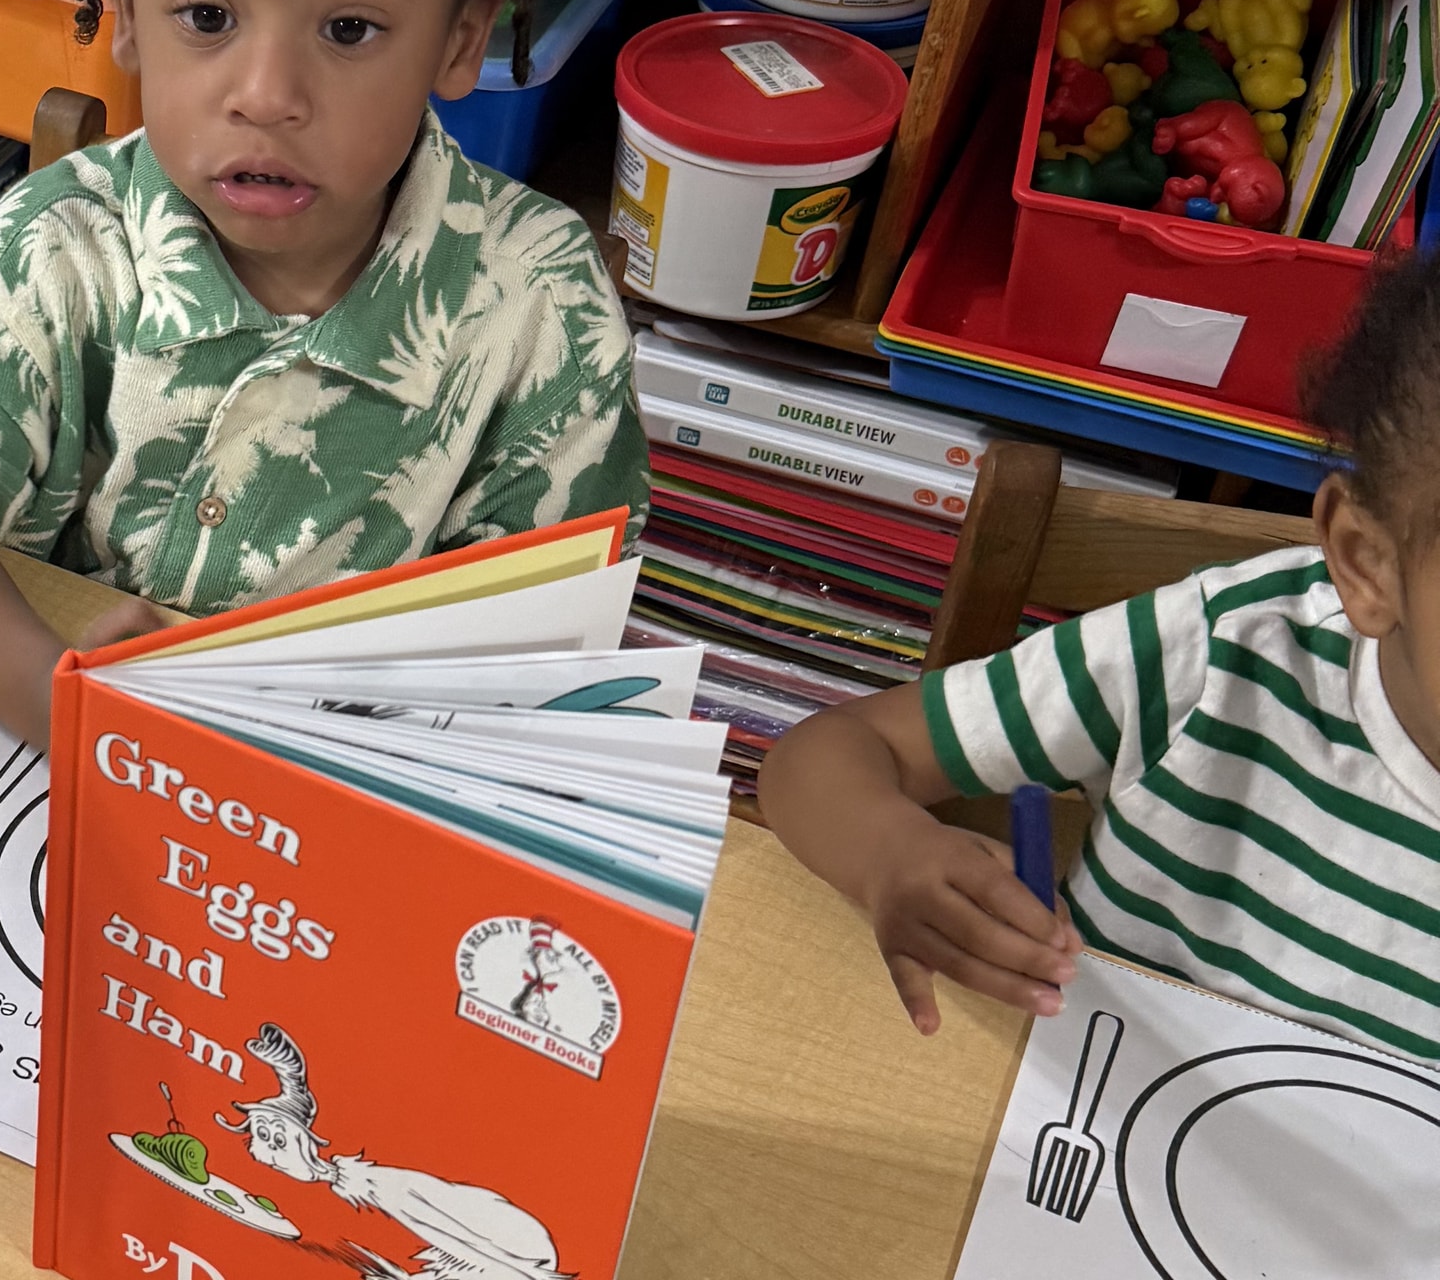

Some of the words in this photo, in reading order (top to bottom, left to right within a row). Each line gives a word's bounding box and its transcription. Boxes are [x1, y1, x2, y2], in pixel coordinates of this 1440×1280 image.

[94, 732, 302, 867] Green
[158, 835, 336, 961] Eggs
[465, 922, 502, 949] READ
[506, 920, 522, 933] IT
[102, 912, 227, 1000] and
[460, 952, 475, 982] CAN
[564, 943, 594, 972] ALL
[592, 974, 614, 995] BY
[99, 973, 245, 1084] Ham
[464, 999, 540, 1044] Beginner
[543, 1037, 597, 1072] Books
[589, 998, 617, 1051] MYSELF
[122, 1233, 168, 1273] By
